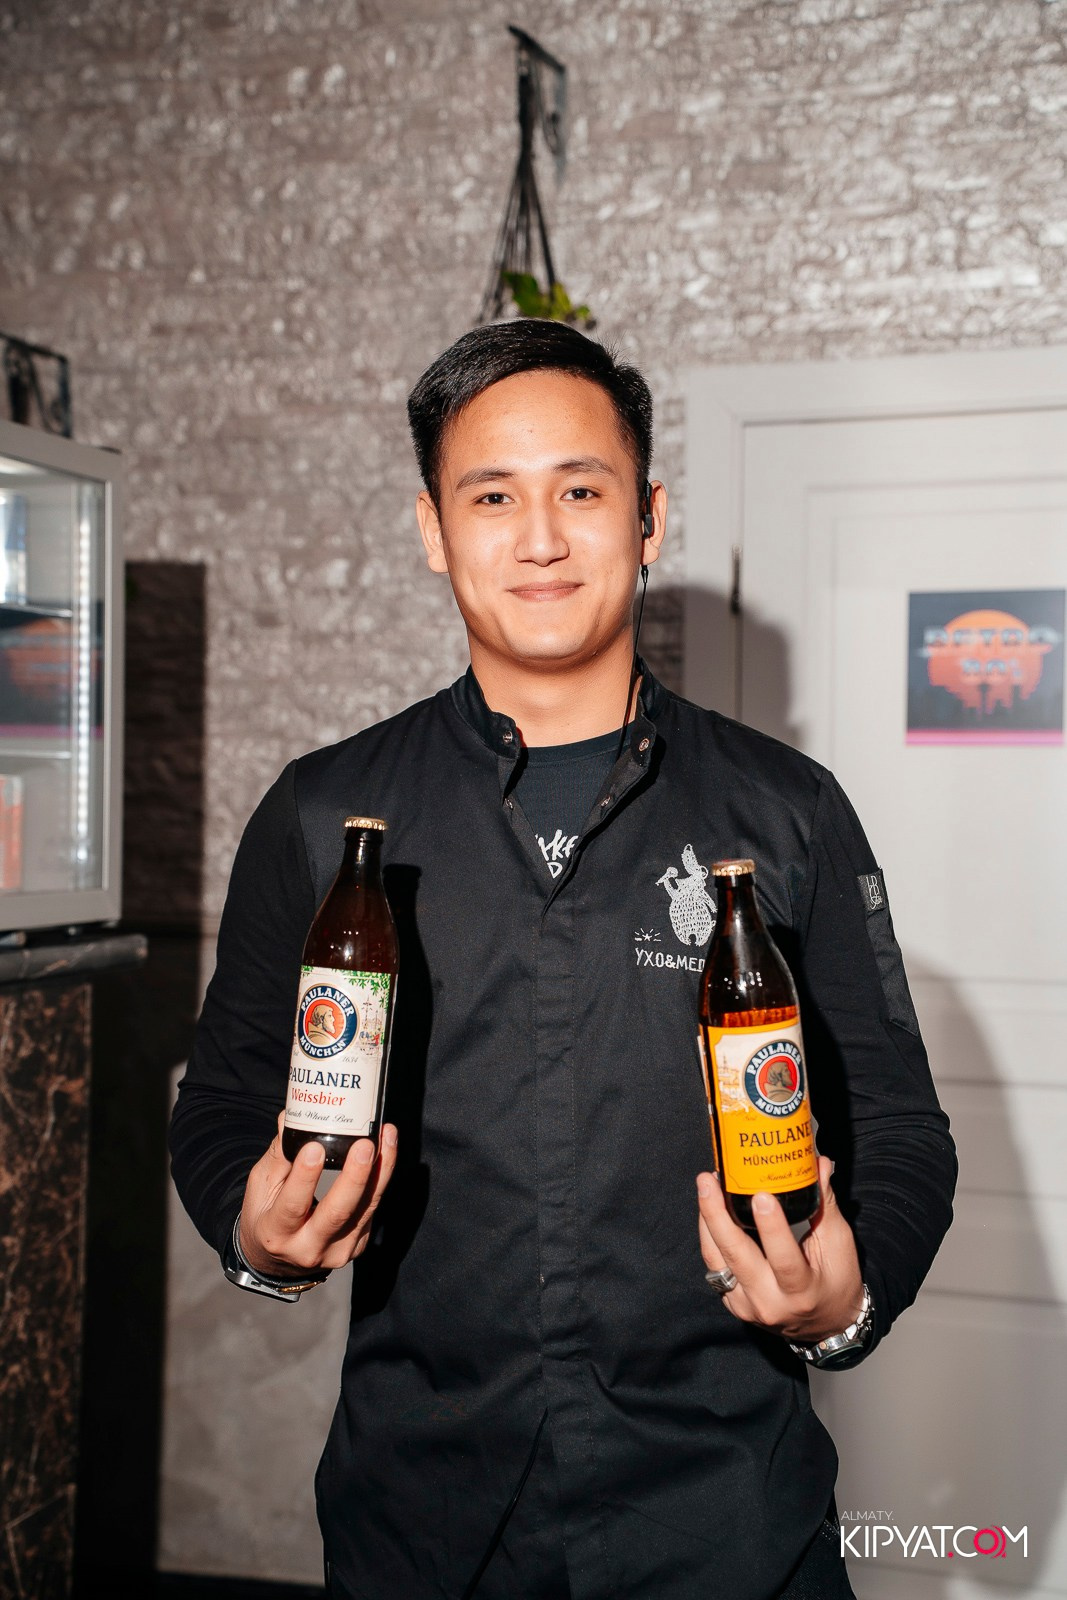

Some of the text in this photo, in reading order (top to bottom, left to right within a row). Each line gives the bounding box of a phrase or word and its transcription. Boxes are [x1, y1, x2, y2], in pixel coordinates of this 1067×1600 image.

[301, 986, 355, 1016] PAULANER
[299, 1036, 347, 1058] MÜNCHEN
[747, 1043, 801, 1075] PAULANER
[288, 1066, 361, 1089] PAULANER
[291, 1087, 346, 1106] Weissbier
[333, 1114, 354, 1124] Beer
[743, 1149, 804, 1166] MÜNCHNER
